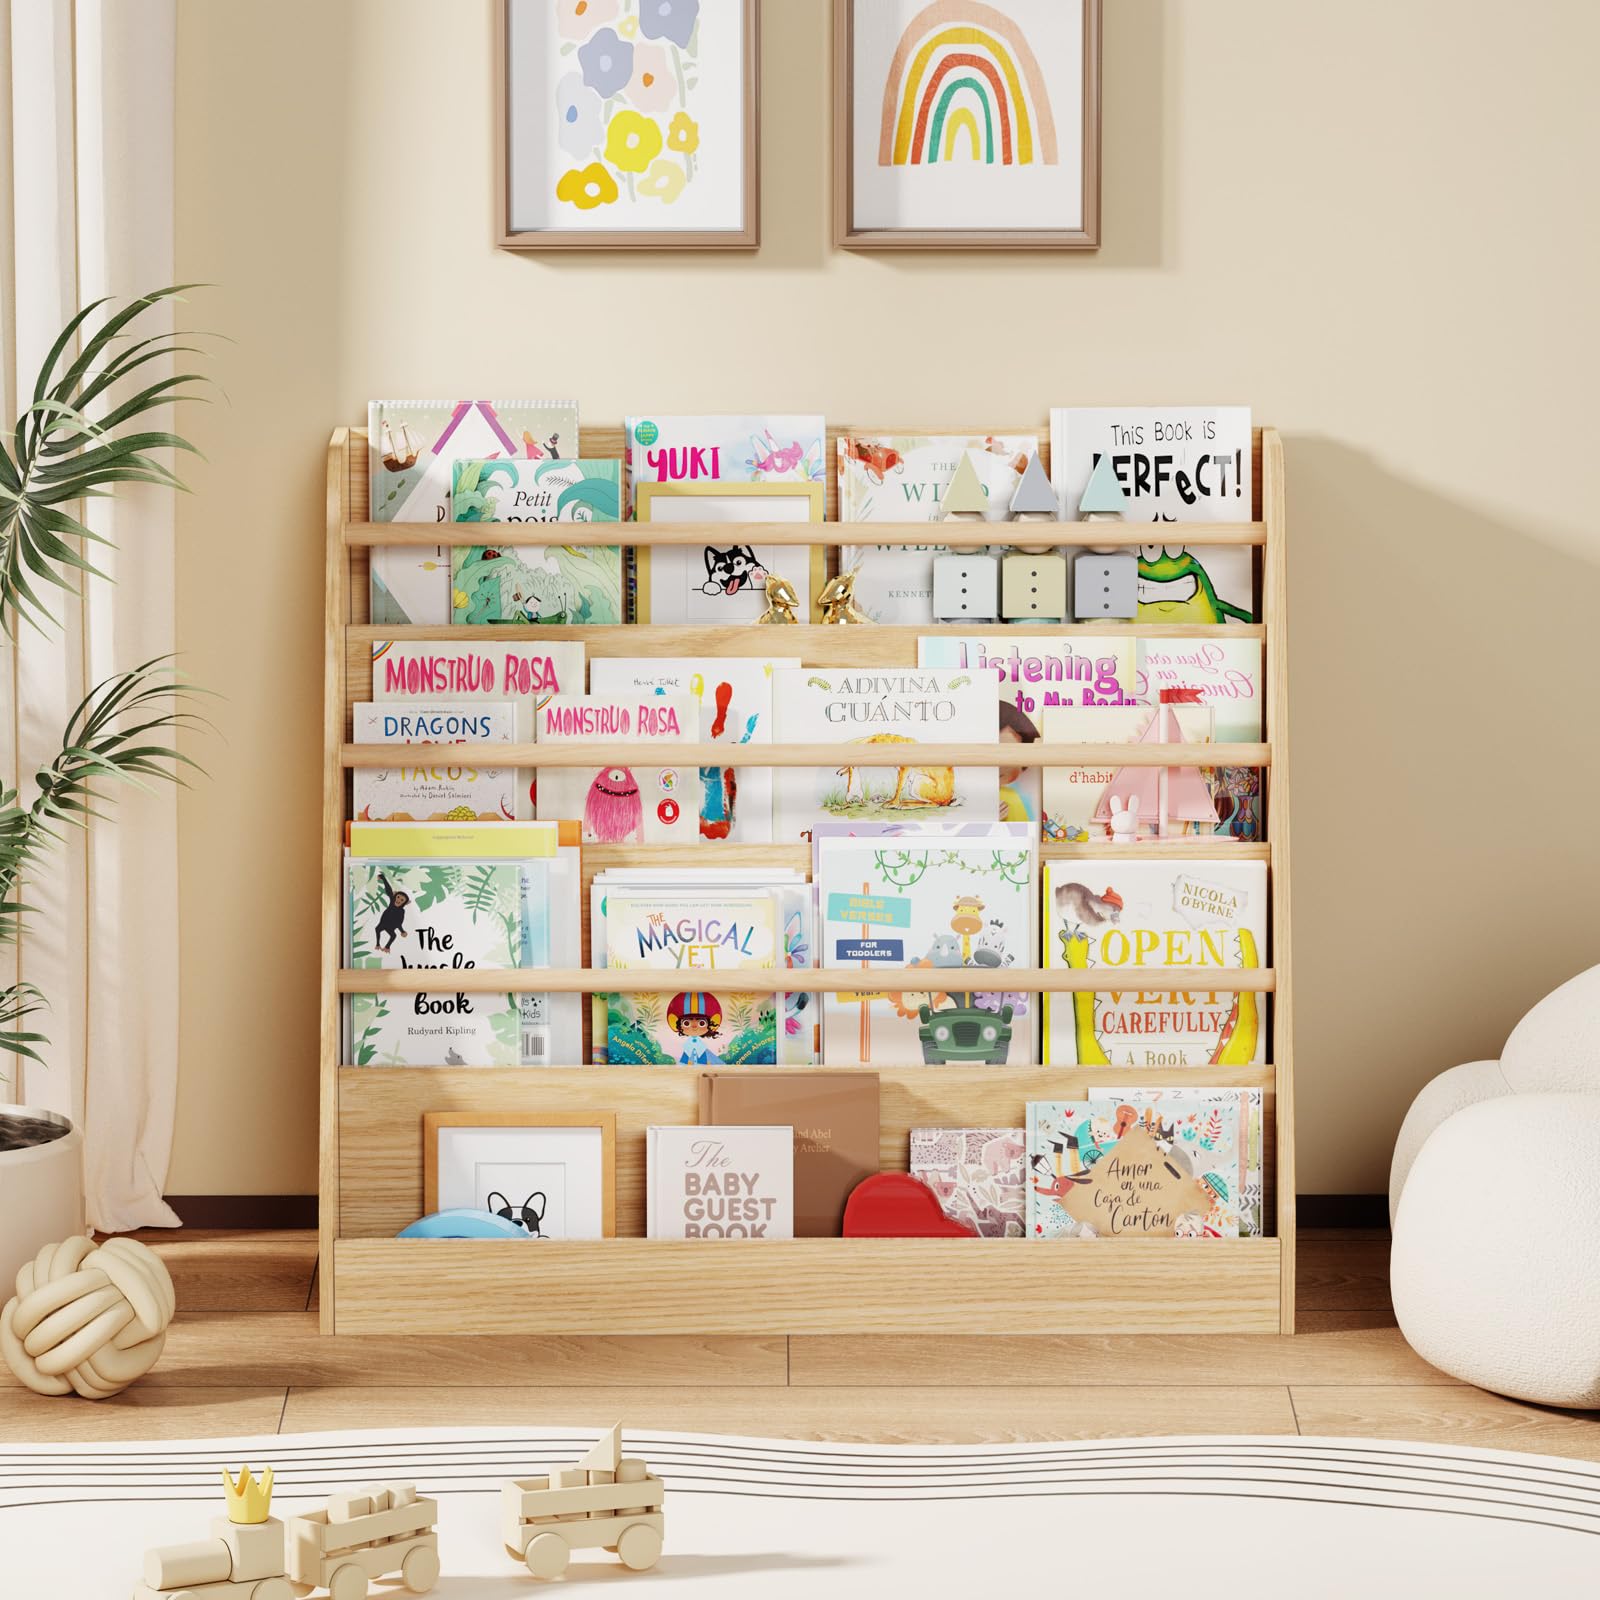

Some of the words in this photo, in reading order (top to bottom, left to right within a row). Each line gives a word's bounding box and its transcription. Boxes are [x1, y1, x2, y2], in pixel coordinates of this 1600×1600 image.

[647, 446, 720, 482] YUKI
[513, 490, 552, 507] Petit
[888, 590, 933, 598] KENNET
[385, 654, 495, 694] MONSTRUO
[503, 653, 560, 694] ROSA
[837, 676, 940, 694] ADIVINA
[825, 695, 956, 722] CUÁNTO
[1016, 690, 1035, 713] to
[384, 716, 491, 737] DRAGONS
[546, 705, 630, 736] MONSTRUO
[637, 704, 681, 736] ROSA
[1069, 771, 1113, 783] d'habit
[1183, 882, 1238, 908] NICOLA
[646, 912, 665, 927] THE
[415, 926, 454, 952] The
[636, 919, 754, 958] MAGICAL
[860, 941, 877, 949] FOR
[1100, 928, 1229, 967] OPEN
[667, 944, 720, 968] YET
[414, 992, 474, 1015] Book
[407, 1026, 443, 1036] Rudyard
[445, 1026, 476, 1036] Kipling
[1102, 1011, 1222, 1034] CAREFULLY
[1126, 1050, 1135, 1065] A
[1144, 1050, 1188, 1065] Book
[810, 1128, 832, 1138] Abel
[685, 1140, 731, 1168] The
[1106, 1157, 1152, 1180] Amor
[685, 1172, 760, 1196] BABY
[1120, 1181, 1134, 1191] en
[1139, 1181, 1163, 1191] una
[684, 1198, 777, 1221] GUEST
[1094, 1189, 1121, 1212] Caja
[1126, 1190, 1141, 1206] de
[685, 1223, 768, 1238] BOOK
[1111, 1205, 1173, 1235] Cartón
